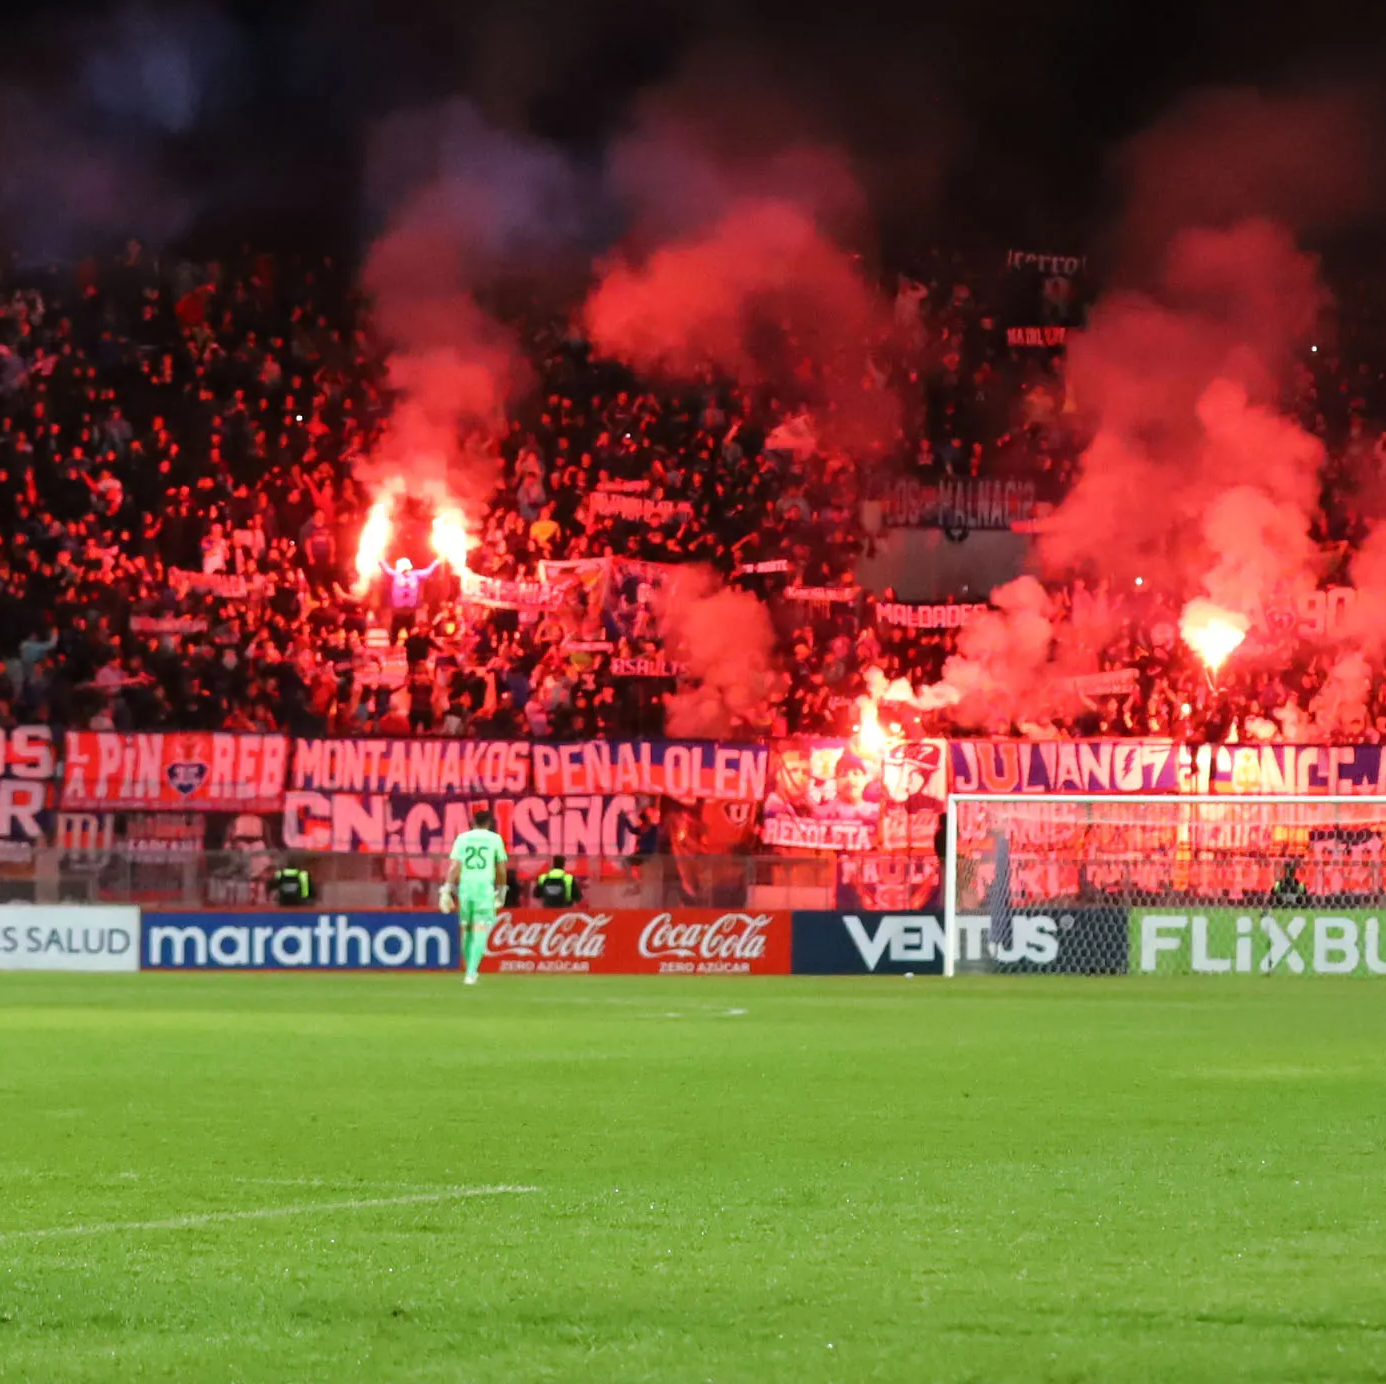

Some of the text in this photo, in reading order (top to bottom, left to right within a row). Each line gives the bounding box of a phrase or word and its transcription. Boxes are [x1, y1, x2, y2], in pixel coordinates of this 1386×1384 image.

[465, 846, 489, 870] 25
[25, 924, 131, 956] SALUD
[148, 916, 450, 966] marathon
[638, 912, 774, 959] Coca-Cola
[842, 915, 1060, 972] VENTUS
